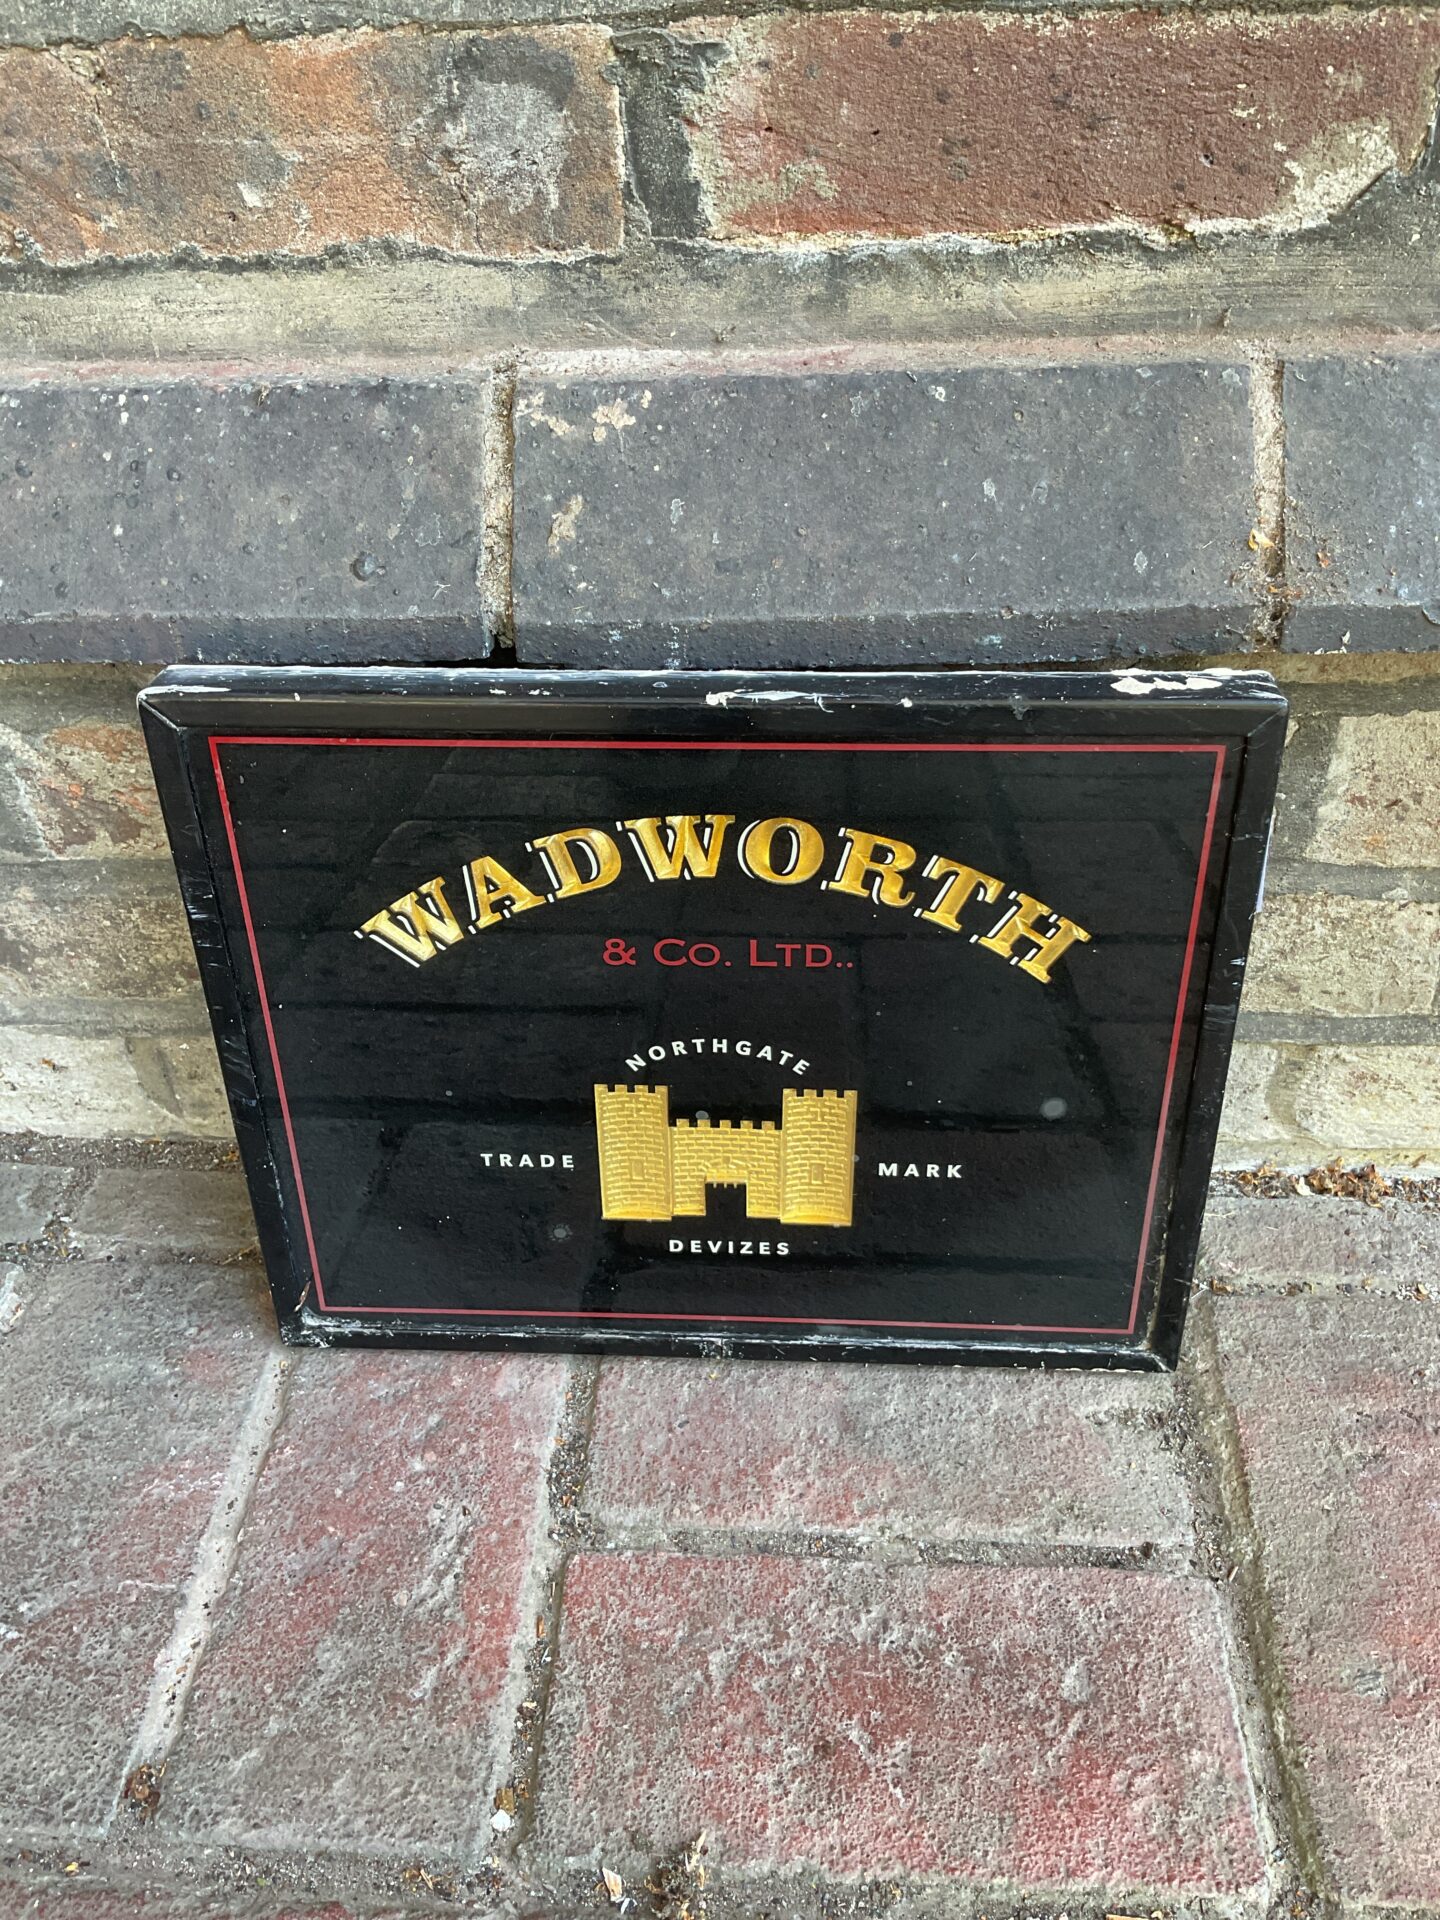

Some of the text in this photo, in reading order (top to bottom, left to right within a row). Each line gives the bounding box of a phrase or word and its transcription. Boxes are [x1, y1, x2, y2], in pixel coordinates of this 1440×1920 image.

[354, 815, 1091, 983] WADWORTH
[603, 938, 636, 966] &
[625, 1039, 811, 1076] NORTHGATE
[480, 1153, 962, 1179] TRADE MARK
[668, 1239, 790, 1256] DEVIZES
